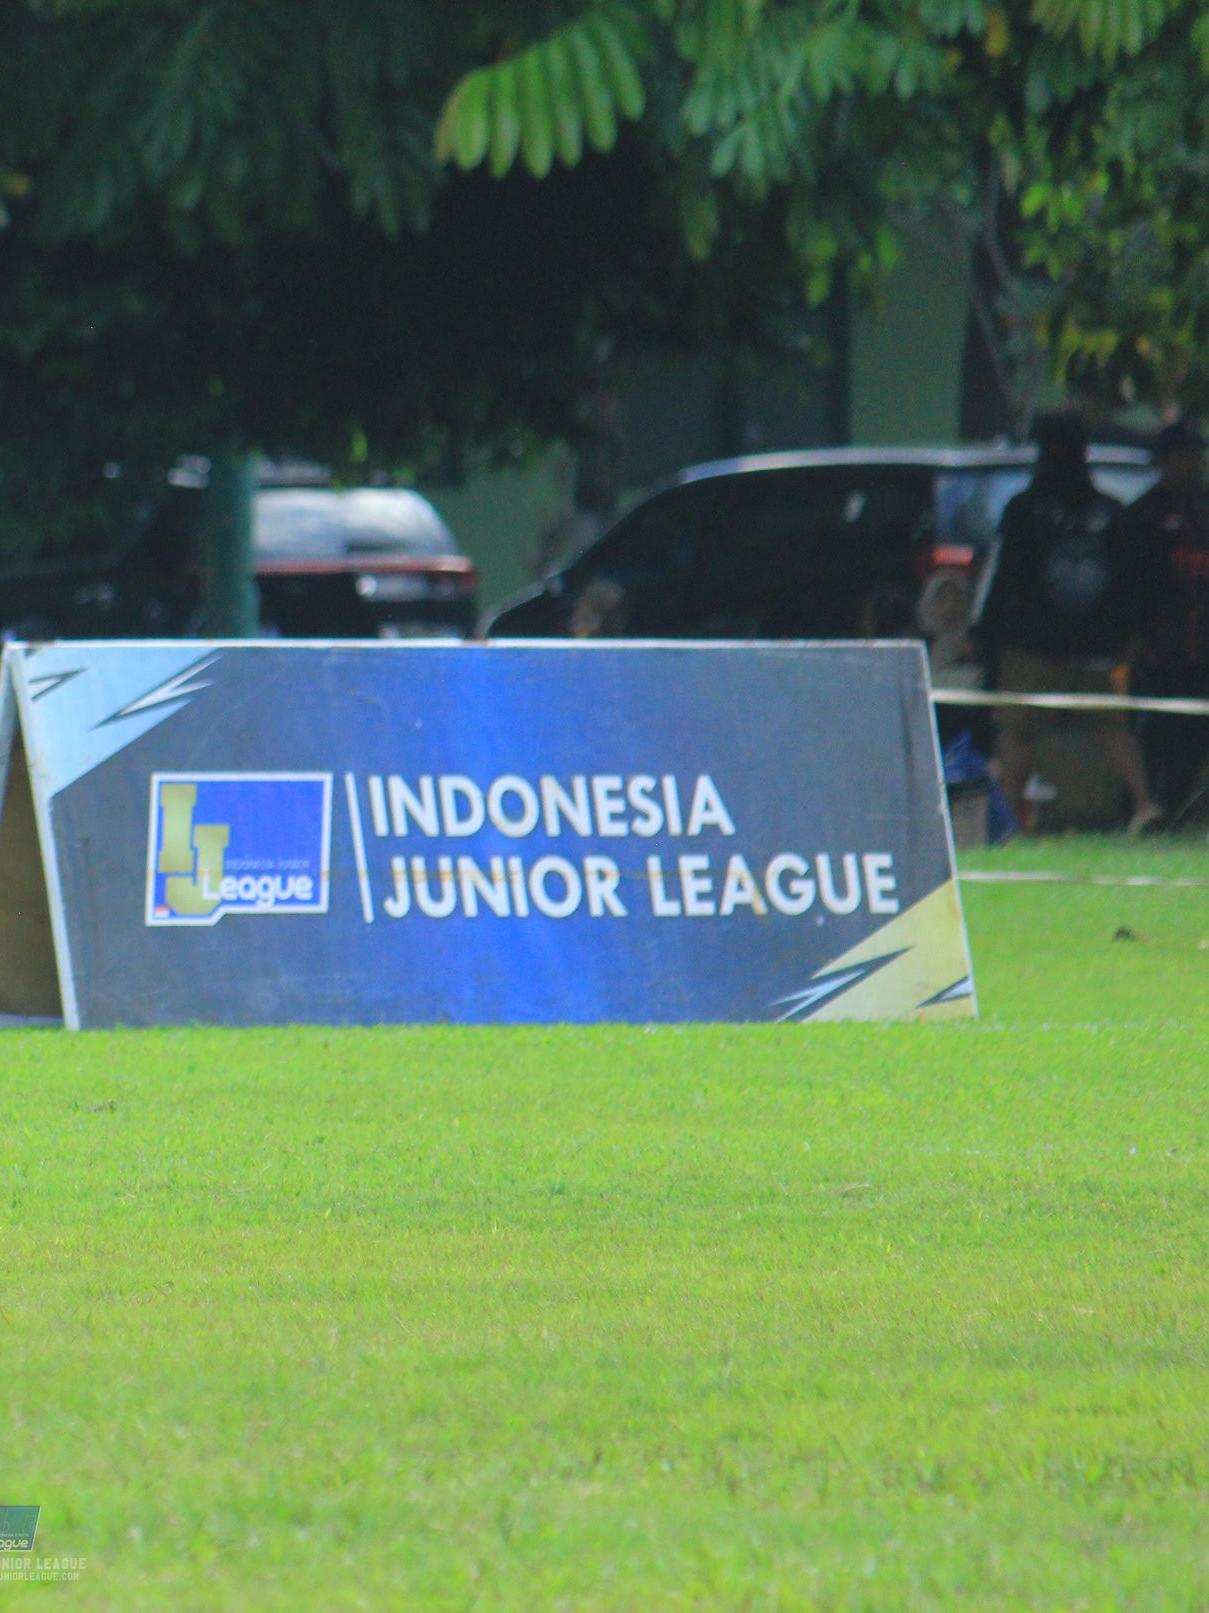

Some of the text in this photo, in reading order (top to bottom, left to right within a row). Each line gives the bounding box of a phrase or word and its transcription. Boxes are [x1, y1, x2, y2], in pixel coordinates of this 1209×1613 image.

[367, 774, 736, 838] INDONESIA
[201, 866, 314, 908] League
[383, 851, 901, 919] JUNIOR LEAGUE
